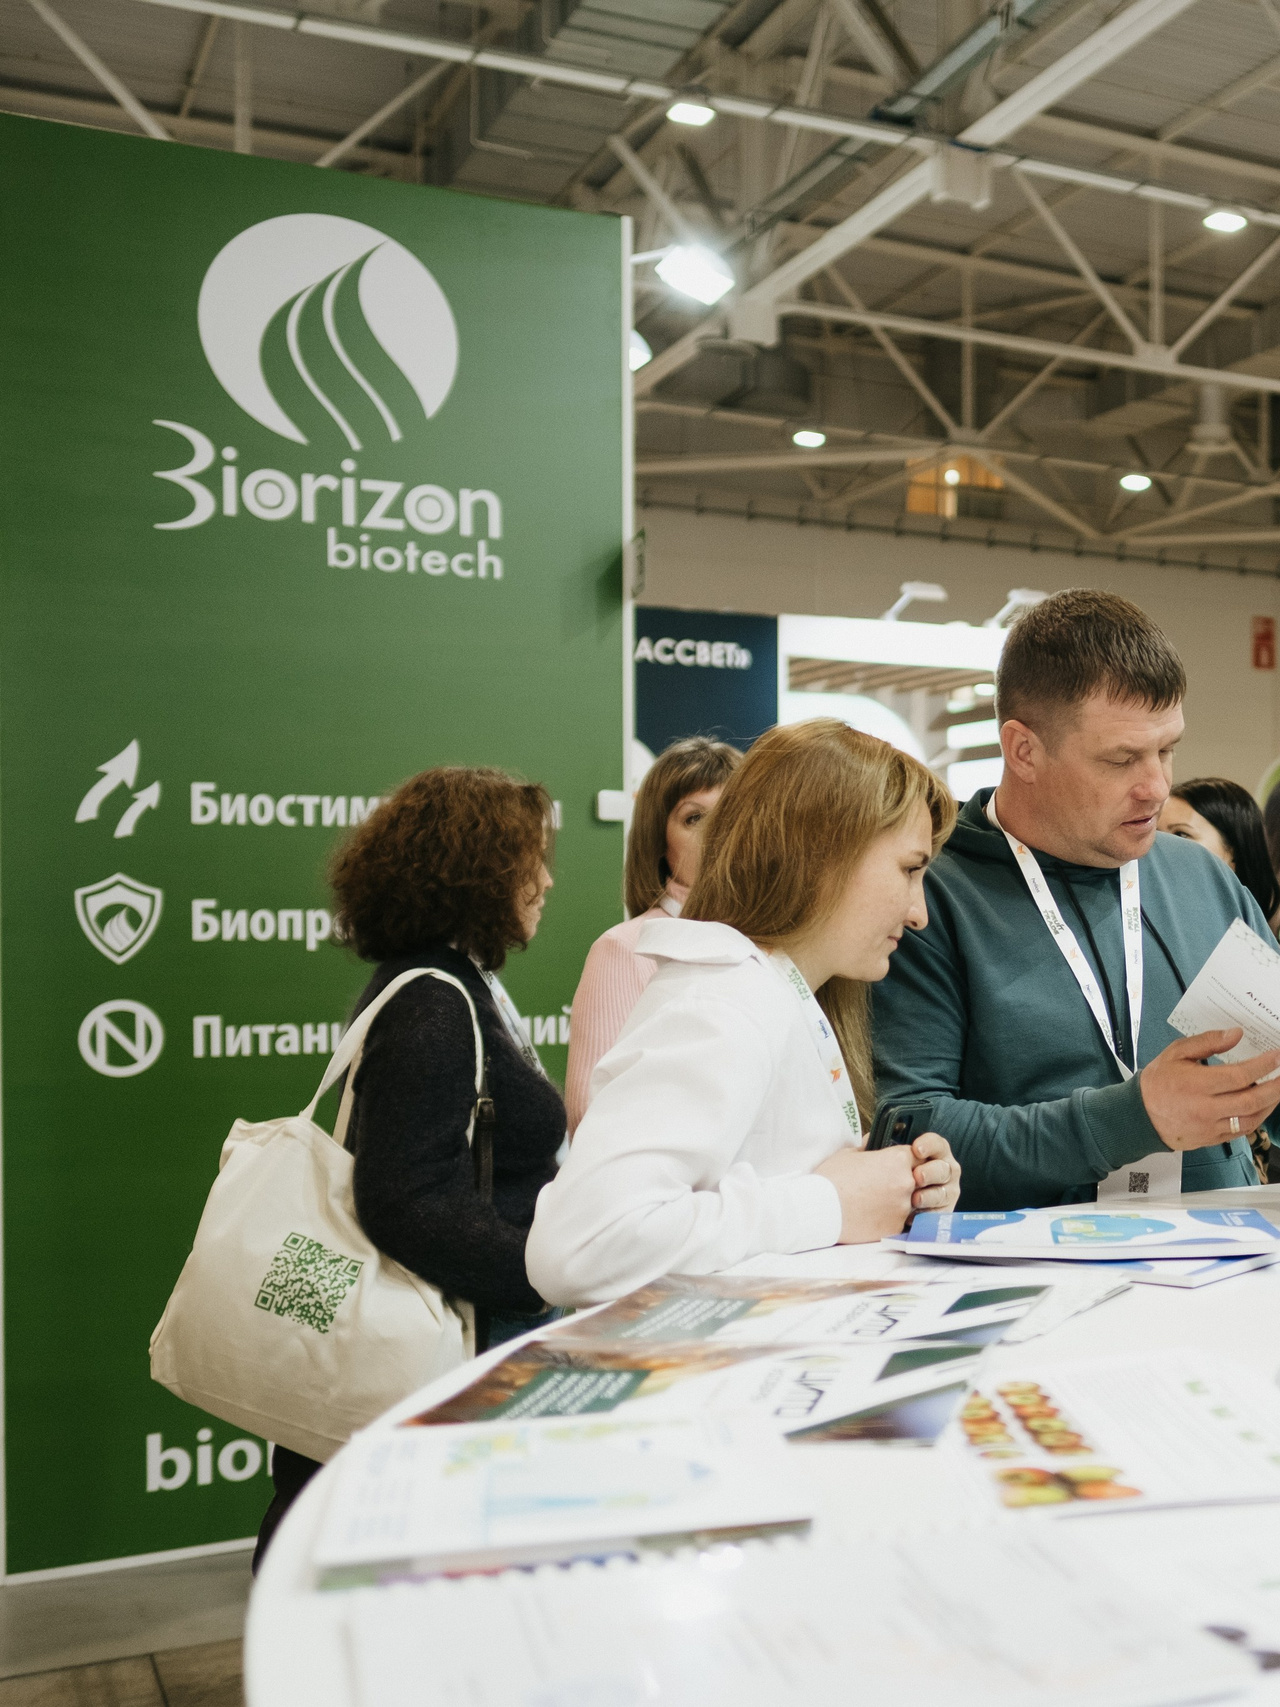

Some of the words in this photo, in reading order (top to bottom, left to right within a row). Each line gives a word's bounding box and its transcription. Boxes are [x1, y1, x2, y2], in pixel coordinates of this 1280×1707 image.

[152, 419, 503, 540] Biorizon
[326, 526, 504, 580] biotech
[634, 636, 753, 670] АССВЕТ»
[190, 898, 346, 952] Биопр
[846, 1101, 860, 1135] TRADE
[145, 1426, 276, 1493] bio
